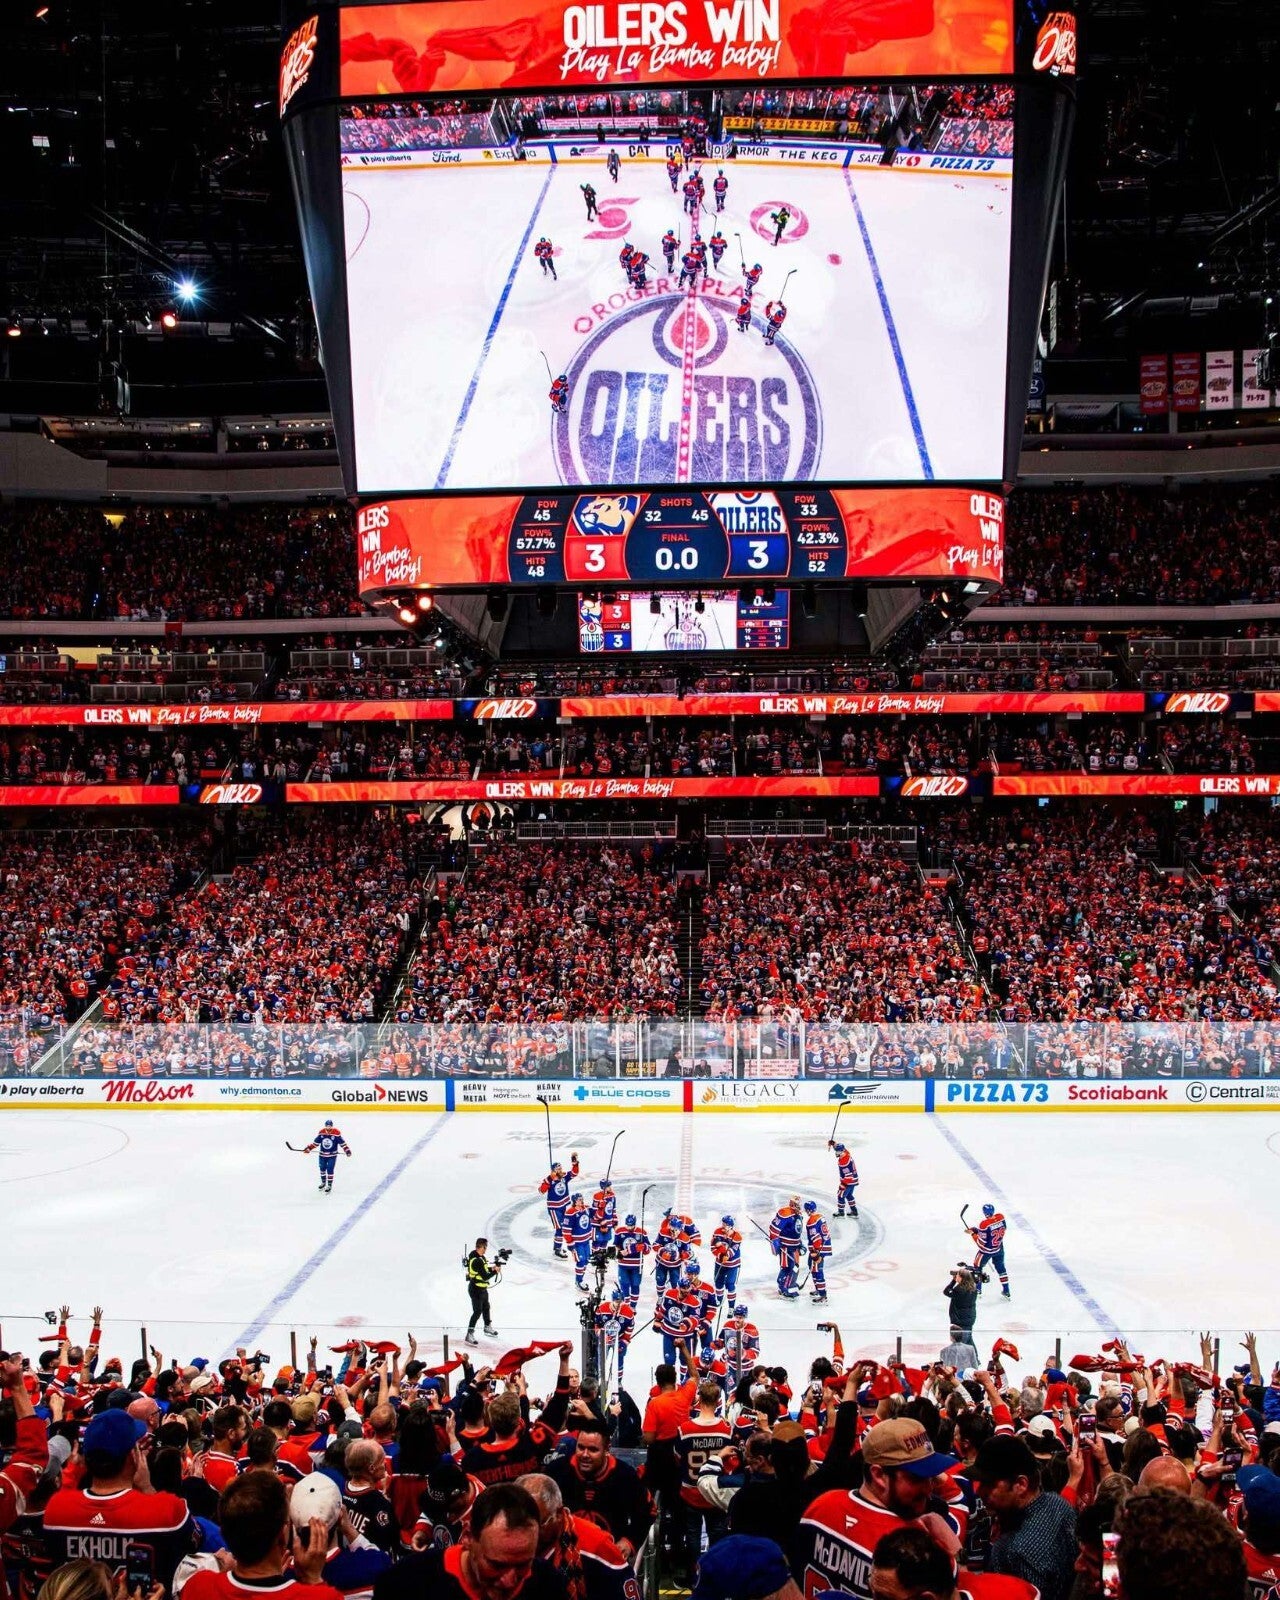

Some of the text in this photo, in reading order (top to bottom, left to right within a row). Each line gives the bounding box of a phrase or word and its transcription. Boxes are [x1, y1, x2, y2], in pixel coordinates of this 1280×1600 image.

[563, 0, 781, 48] OILERS WIN
[559, 41, 781, 80] Play La Bamba, baby!
[432, 151, 461, 162] Ford
[628, 145, 650, 157] CAT
[779, 150, 838, 161] THE KEG
[930, 157, 995, 171] PIZZA 73
[578, 370, 791, 483] OILERS
[660, 498, 693, 507] SHOTS
[794, 496, 816, 504] FOW
[800, 504, 818, 516] 33
[970, 494, 1003, 523] OILER
[533, 510, 551, 521] 45
[644, 510, 662, 522] 32
[691, 510, 709, 521] 45
[716, 506, 782, 533] OILERS
[524, 529, 553, 537] FOW%
[801, 524, 831, 532] FOW%
[979, 518, 1000, 543] WIN
[362, 529, 381, 554] WIN
[516, 538, 556, 549] 57.7%
[661, 534, 690, 542] FINAL
[797, 532, 840, 544] 42.3%
[585, 544, 607, 573] 3
[655, 547, 699, 571] 0.0
[747, 541, 769, 569] 3
[808, 552, 829, 560] HITS
[946, 545, 979, 571] Play
[385, 556, 421, 585] baby!
[527, 566, 545, 577] 48
[808, 561, 826, 572] 52
[612, 605, 623, 619] 3
[613, 634, 623, 648] 3
[759, 694, 945, 713] OILERS WIN Play La Bamba, baby!
[84, 704, 262, 724] OILERS WIN Play La Bamba, baby!
[486, 779, 675, 798] OILERS WIN Play La Bamba, baby!
[1200, 777, 1270, 793] OILERS WIN
[9, 1085, 84, 1096] play alberta
[101, 1080, 194, 1102] Molson
[220, 1087, 302, 1096] why.edmonton.ca
[331, 1090, 428, 1102] Global NEWS
[626, 1090, 671, 1098] CROSS
[721, 1084, 800, 1097] LEGACY
[948, 1083, 1049, 1102] PIZZA 73
[1068, 1085, 1168, 1101] Scotiabank
[1209, 1086, 1264, 1098] Central
[463, 1094, 487, 1102] METAL
[692, 1438, 723, 1448] McDAVID
